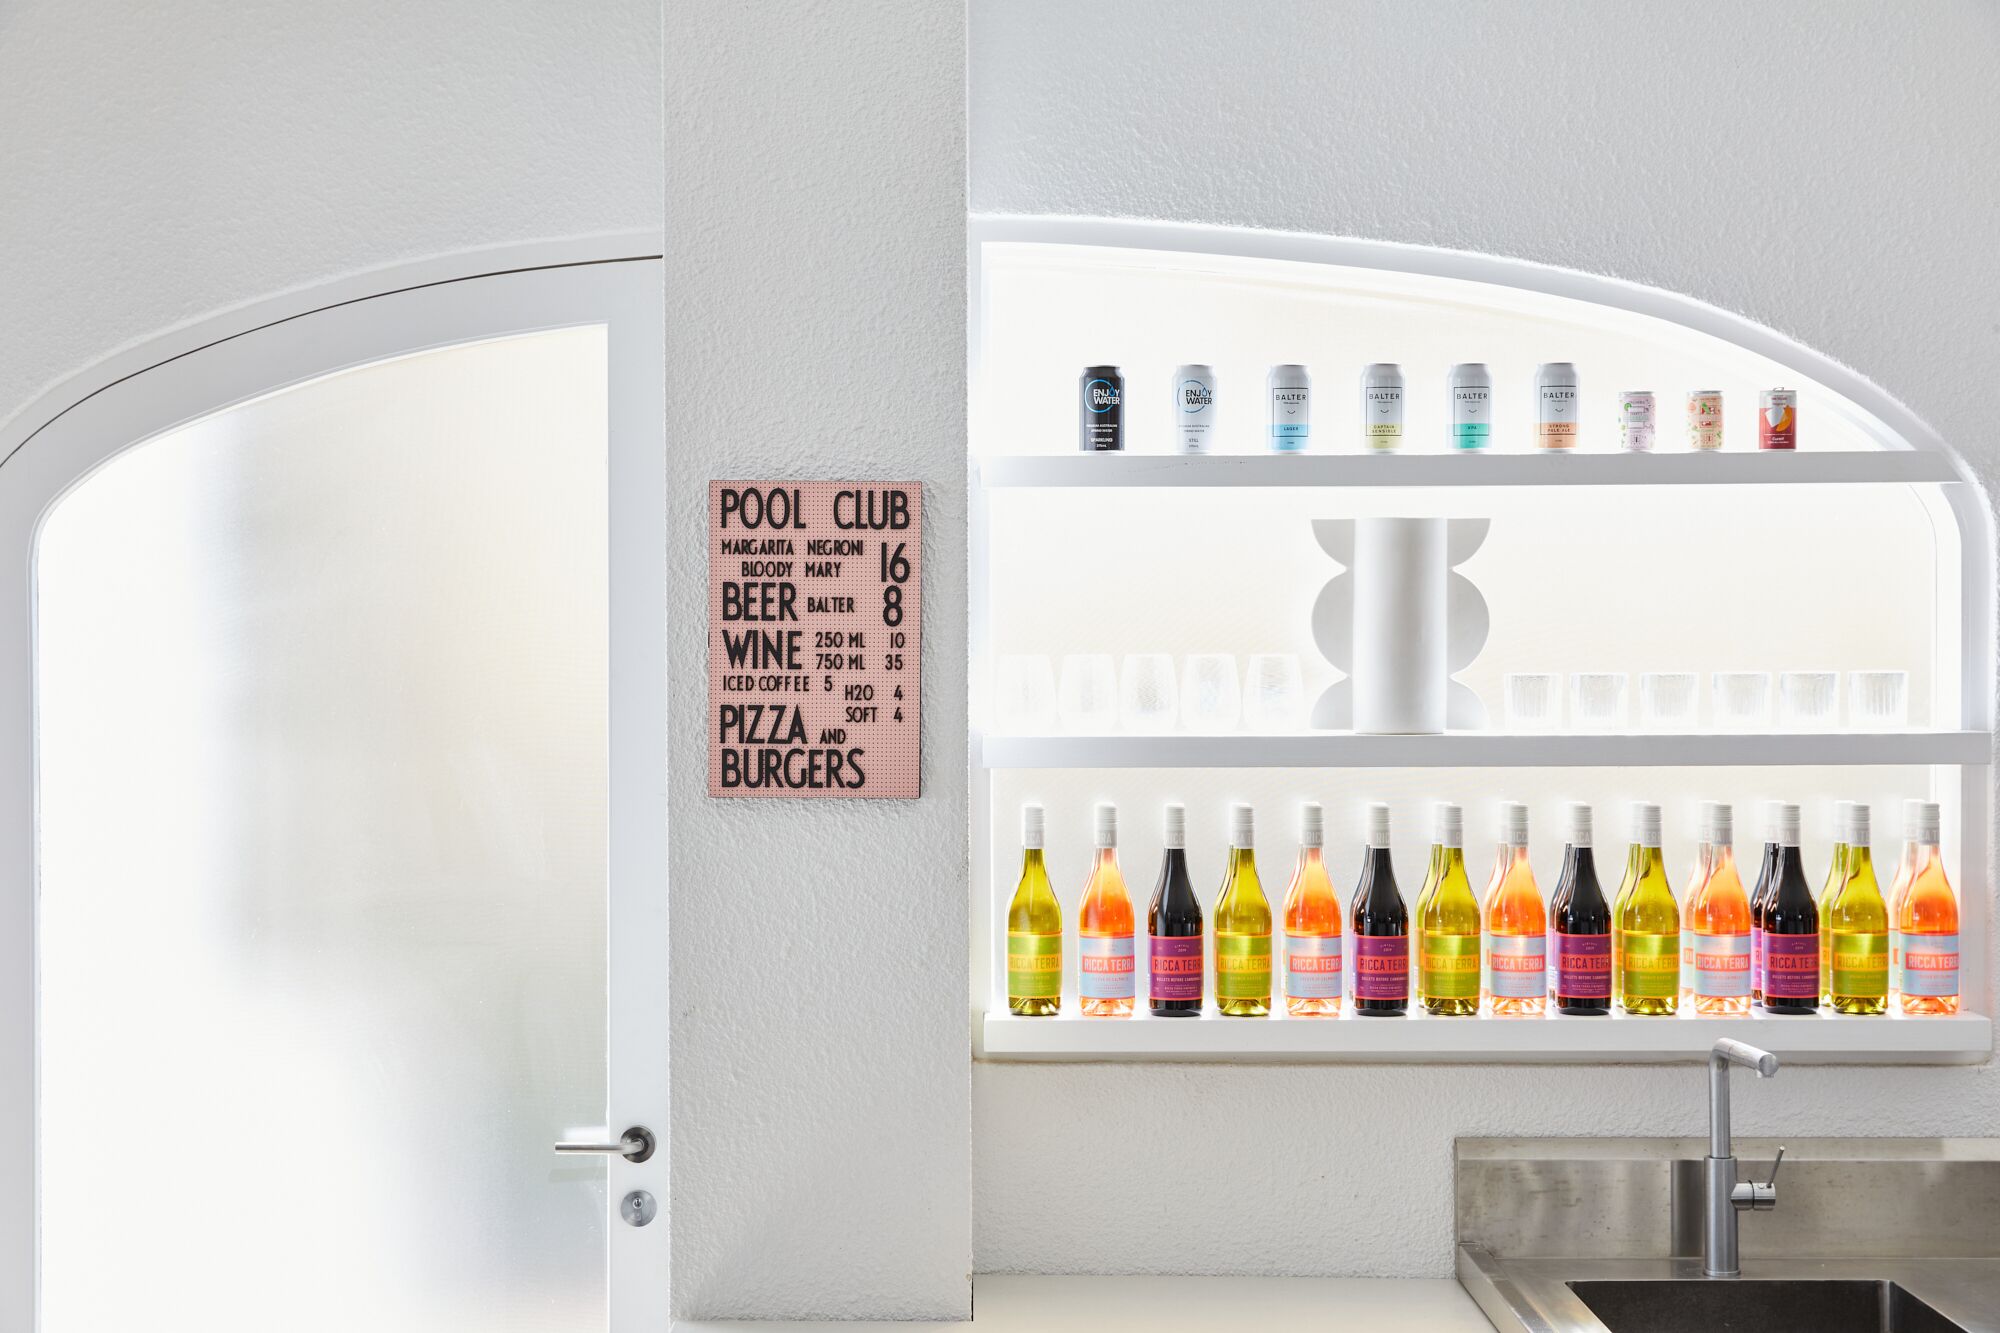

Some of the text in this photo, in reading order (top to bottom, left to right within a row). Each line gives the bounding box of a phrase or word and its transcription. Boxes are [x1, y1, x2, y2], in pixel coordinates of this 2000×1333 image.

[1093, 397, 1120, 405] WATER
[1186, 397, 1212, 405] WATER
[720, 487, 911, 530] POOL CLUB
[721, 539, 864, 556] MARGARITA NEGRONI
[881, 542, 911, 583] 16
[742, 561, 841, 578] BLOODY MARY
[722, 581, 903, 627] BEER BALTER 8
[722, 630, 906, 670] WINE 250 ML 10
[815, 653, 904, 670] 750 ML 35
[723, 675, 833, 692] ICED COFFEE 5
[893, 685, 903, 701] 4
[845, 706, 903, 723] SOFT 4
[719, 704, 847, 745] PIZZA AND
[721, 747, 866, 789] BURGERS
[1010, 957, 1060, 970] RICCA TERRA
[1084, 958, 1109, 971] RICCA
[1154, 959, 1180, 971] RICCA
[1221, 958, 1244, 970] RICCA
[1292, 958, 1318, 971] RICCA
[1360, 958, 1386, 971] RICCA
[1425, 957, 1477, 970] RICCA TERRA
[1492, 957, 1543, 971] RICCA TERRA
[1562, 957, 1588, 969] RICCA
[1629, 957, 1654, 969] RICCA
[1698, 956, 1721, 969] RICCA
[1722, 956, 1749, 969] TERRA
[1770, 956, 1797, 969] RICCA
[1838, 956, 1863, 969] RICCA
[1909, 956, 1936, 969] RICCA
